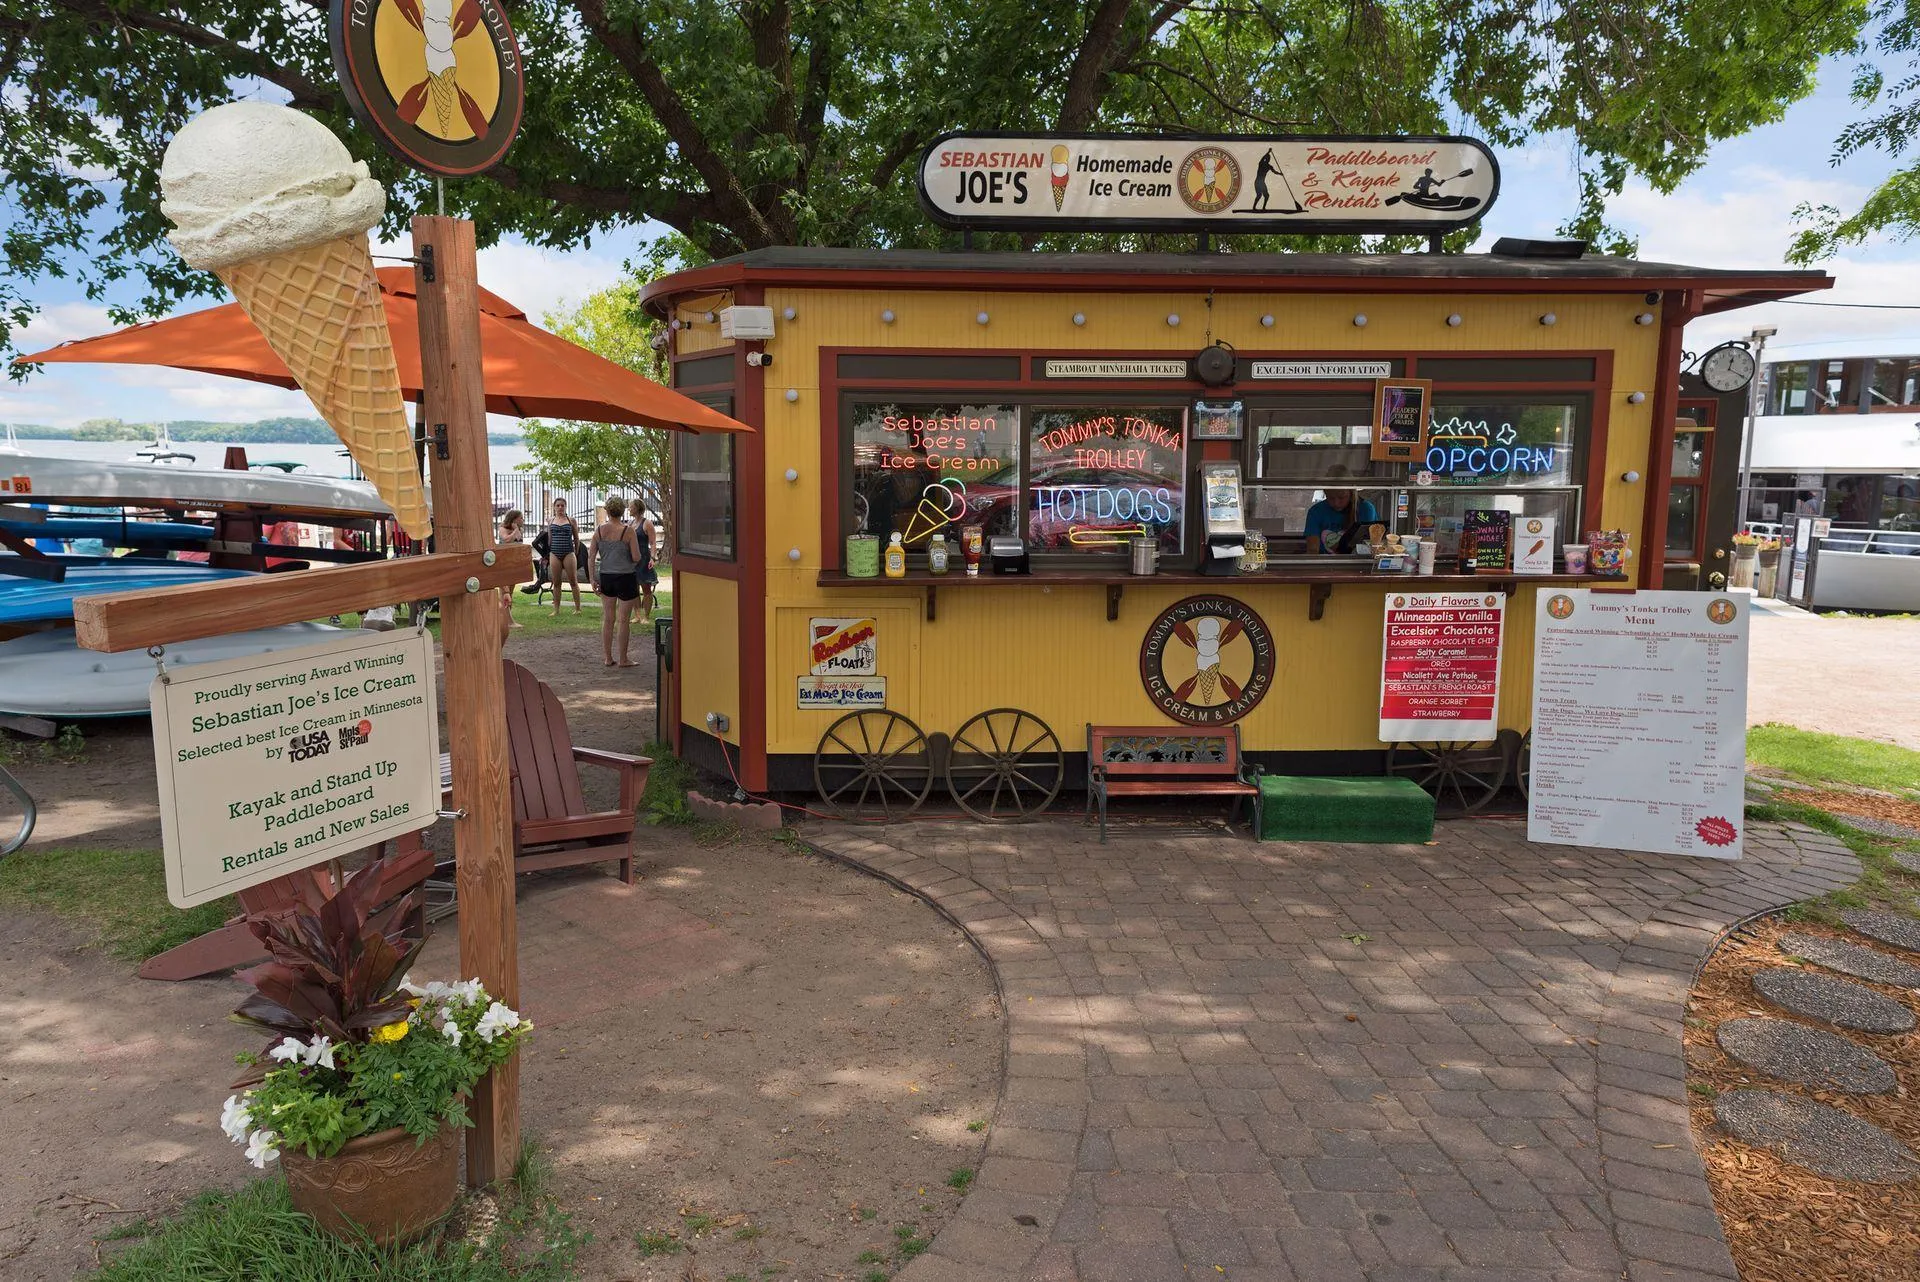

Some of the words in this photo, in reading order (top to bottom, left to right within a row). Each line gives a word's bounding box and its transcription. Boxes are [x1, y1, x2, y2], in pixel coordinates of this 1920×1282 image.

[478, 0, 517, 76] ROLLEY
[940, 151, 1045, 169] SEBASTIAN
[1076, 154, 1173, 174] Homemade
[1306, 147, 1438, 167] Paddleboard
[955, 170, 1029, 204] JOE'S
[1089, 178, 1115, 196] Ice
[1117, 178, 1172, 197] Cream
[1301, 171, 1319, 188] &
[1331, 170, 1401, 194] Kayak
[1303, 191, 1381, 210] Rentals
[1048, 364, 1098, 374] STEAMBOAT
[1099, 364, 1148, 374] MINNEHAHA
[1149, 364, 1185, 374] TICKETS
[1256, 364, 1312, 375] EXCELSIOR
[1315, 364, 1387, 375] INFORMATION
[882, 416, 996, 432] Sebastian
[909, 434, 966, 450] Joe's
[1038, 417, 1116, 454] TOMMY'S
[1123, 418, 1183, 452] TONKA
[880, 453, 916, 470] Ice
[926, 453, 1000, 470] Cream
[1074, 448, 1147, 470] TROLLEY
[1409, 447, 1554, 473] OPCORN
[1410, 597, 1437, 608] Daily
[1441, 597, 1479, 606] Flavors
[1590, 604, 1629, 613] Tommy's
[1631, 605, 1658, 613] Tonka
[1661, 607, 1691, 615] Trolley
[1394, 613, 1454, 623] Minneapolis
[1458, 612, 1493, 621] Vanilla
[1625, 615, 1655, 624] Menu
[1146, 607, 1187, 657] TOMMY'S
[1188, 601, 1233, 615] TONKA
[1237, 610, 1269, 657] TROLLEY
[1391, 626, 1439, 636] Excelsior
[1443, 626, 1494, 635] Chocolate
[828, 657, 865, 669] FLOATS
[1417, 649, 1436, 657] Salty
[194, 684, 252, 704] Proudly
[256, 672, 307, 692] serving
[310, 662, 351, 680] Award
[354, 652, 404, 671] Winning
[192, 702, 284, 734] Sebastian
[287, 691, 330, 716] Joe's
[333, 685, 359, 701] Ice
[363, 672, 416, 694] Cream
[800, 688, 812, 698] Eat
[813, 689, 838, 699] More
[841, 689, 855, 699] Ice
[856, 689, 883, 700] Cream
[1148, 675, 1166, 698] ICE
[1163, 697, 1208, 721] CREAM
[1215, 710, 1223, 720] &
[1227, 674, 1266, 716] KAYAKS
[178, 737, 243, 762] Selected
[246, 730, 276, 747] best
[278, 723, 300, 738] Ice
[302, 713, 346, 732] Cream
[348, 709, 362, 720] in
[362, 694, 424, 718] Minnesota
[265, 745, 284, 760] by
[302, 730, 331, 747] USA
[338, 725, 360, 741] Mpls
[288, 741, 332, 763] TODAY
[339, 738, 349, 750] St
[350, 733, 369, 747] Paul
[228, 792, 286, 820] Kayak
[290, 780, 323, 801] and
[326, 765, 372, 790] Stand
[375, 760, 398, 779] Up
[264, 786, 375, 832] Paddleboard
[221, 841, 288, 873] Rentals
[293, 827, 326, 849] and
[329, 814, 367, 838] New
[370, 802, 410, 824] Sales
